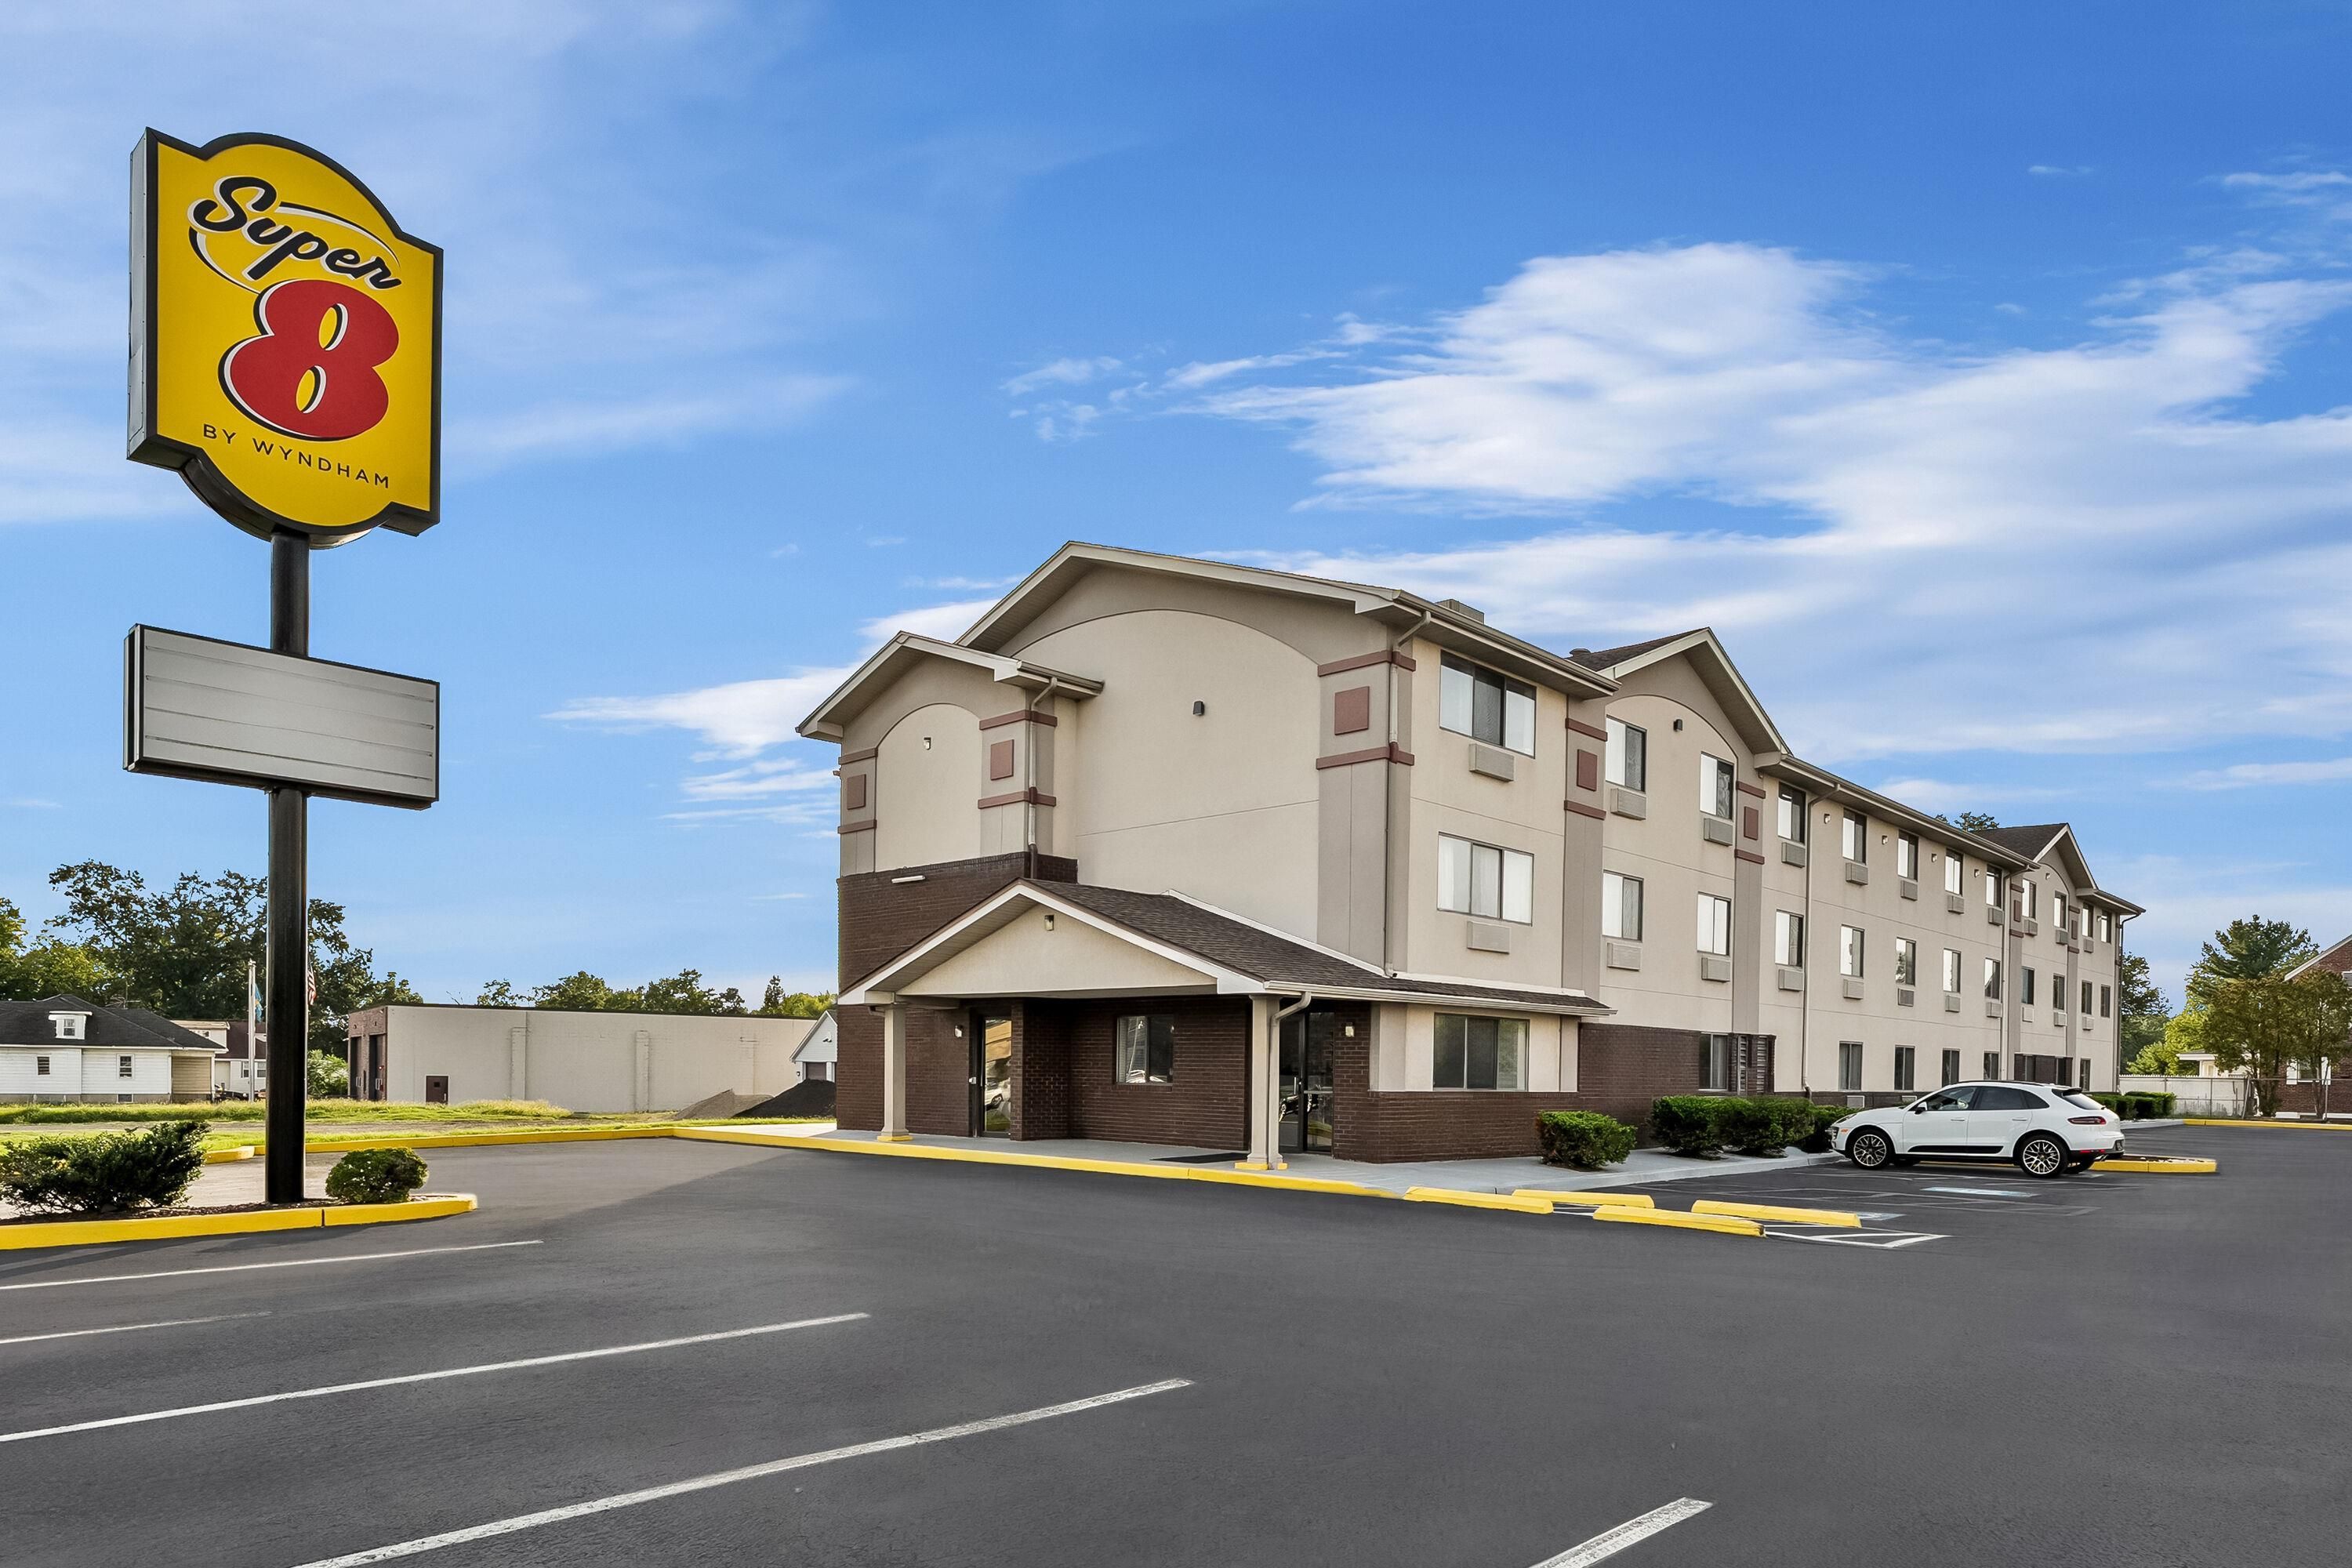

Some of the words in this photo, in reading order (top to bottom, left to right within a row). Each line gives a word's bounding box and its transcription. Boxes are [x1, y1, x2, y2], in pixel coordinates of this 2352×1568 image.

[187, 176, 401, 289] Super
[218, 279, 398, 441] 8
[203, 423, 237, 445] BY
[252, 437, 390, 488] WYNDHAM
